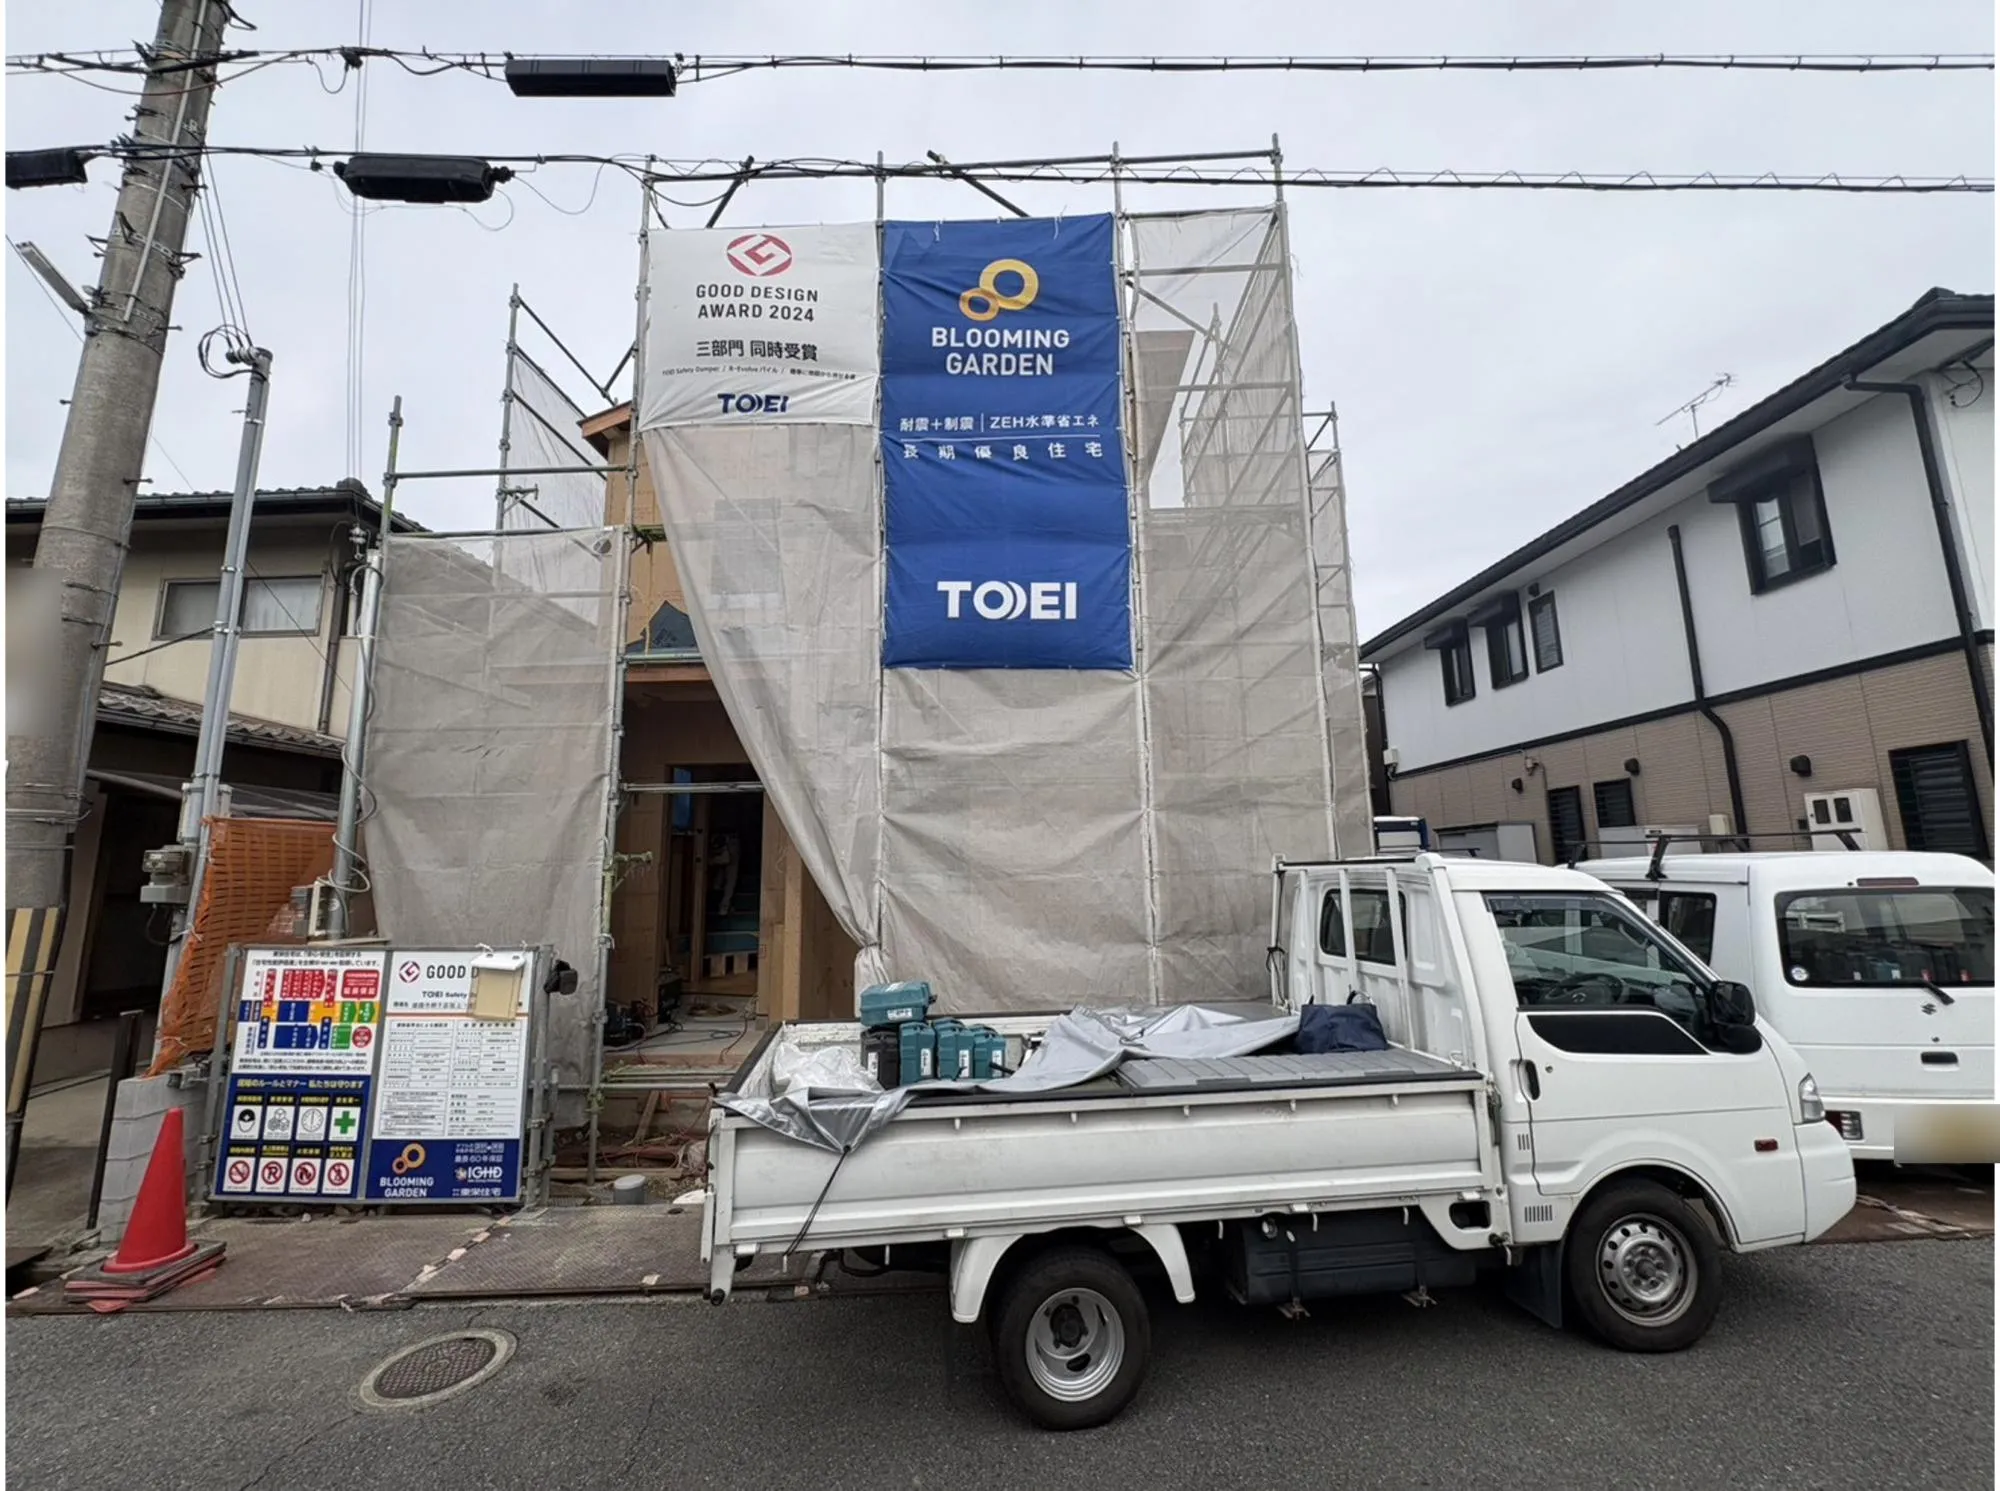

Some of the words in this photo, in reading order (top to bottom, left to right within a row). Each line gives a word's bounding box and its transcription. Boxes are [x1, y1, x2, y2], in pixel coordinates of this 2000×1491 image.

[696, 284, 744, 299] GOOD
[751, 286, 818, 302] DESIGN
[698, 303, 763, 319] AWARD
[769, 304, 814, 322] 2024
[931, 327, 1070, 349] BLOOMING
[696, 339, 744, 358] 三部門
[750, 340, 818, 362] 同時受賞
[946, 353, 1054, 376] GARDEN
[717, 393, 790, 414] TOEI
[990, 414, 1100, 430] ZEH水準省エネ
[937, 580, 1077, 620] TOEI
[426, 965, 466, 979] GOOD
[380, 1177, 434, 1187] BLOOMING
[384, 1188, 427, 1198] GARDEN
